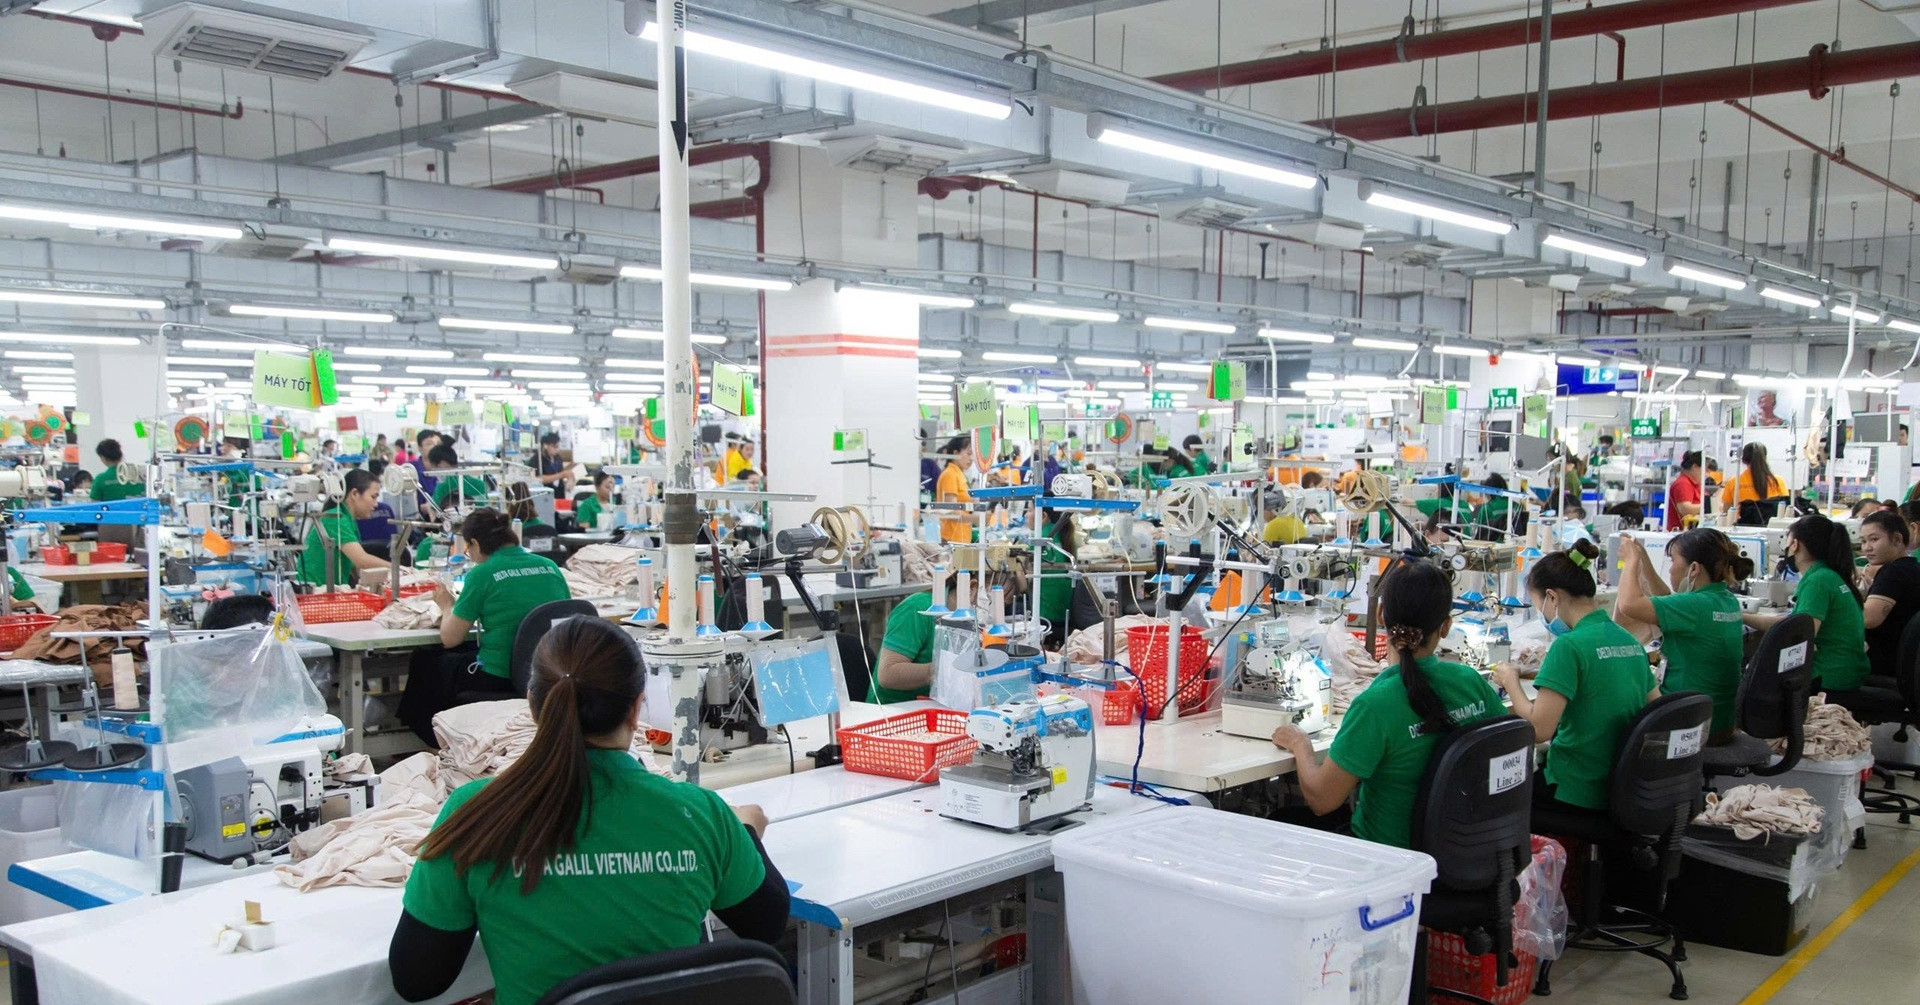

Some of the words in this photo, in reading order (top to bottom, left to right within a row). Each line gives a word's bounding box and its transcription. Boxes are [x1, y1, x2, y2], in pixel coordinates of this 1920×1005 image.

[674, 0, 683, 31] OMP.
[264, 373, 288, 388] MÁY
[291, 376, 312, 392] TỐT
[1153, 399, 1172, 408] 217
[1496, 776, 1513, 788] Line
[555, 853, 594, 877] GALIL
[594, 851, 653, 876] VIETNAM
[655, 849, 698, 875] CO.,LTD.
